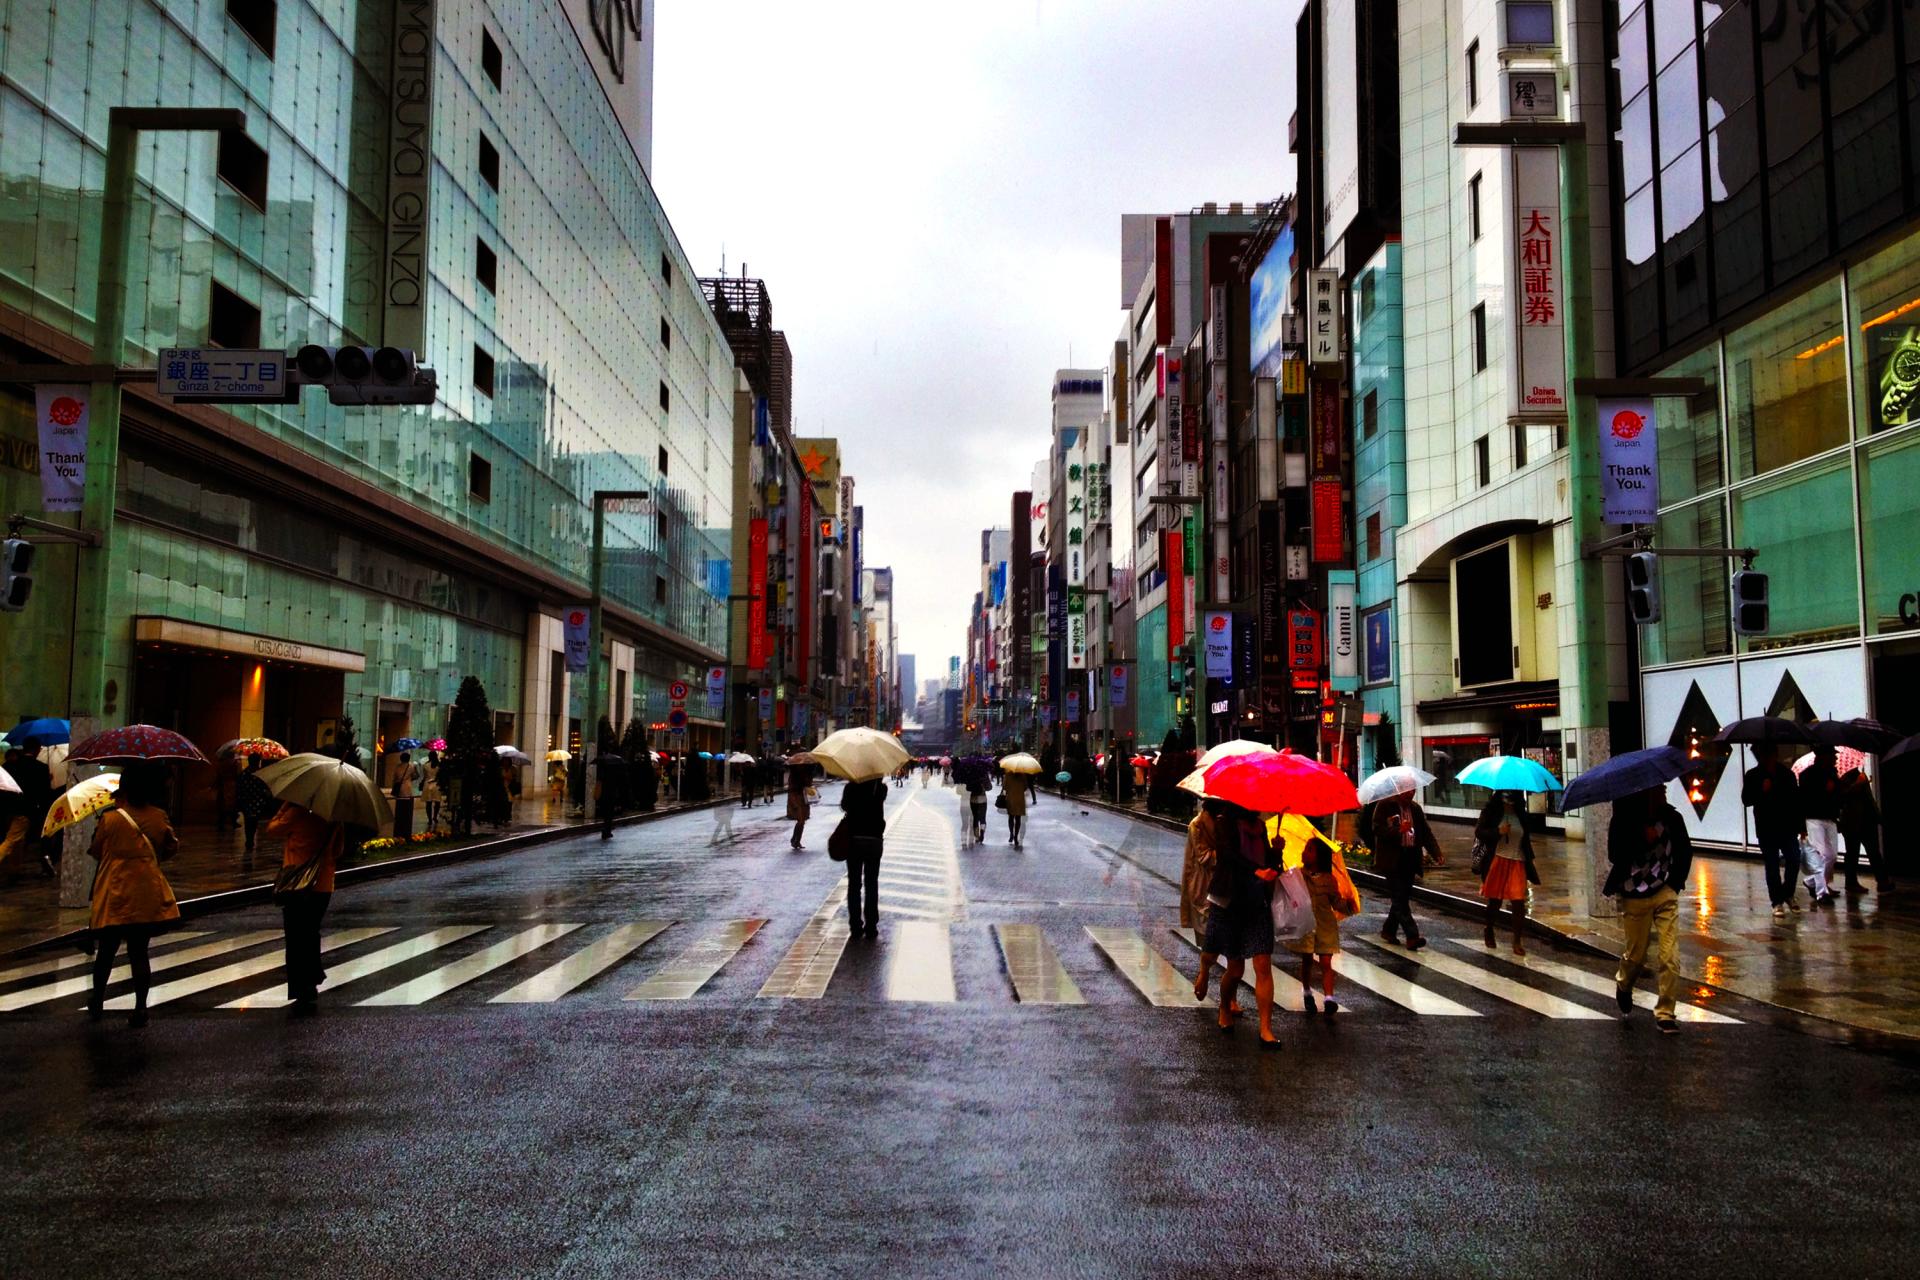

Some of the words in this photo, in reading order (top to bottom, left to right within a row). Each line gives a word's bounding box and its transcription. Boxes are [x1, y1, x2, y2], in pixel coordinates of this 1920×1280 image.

[1521, 209, 1555, 326] 大和証券
[1317, 278, 1332, 356] 南風ビル
[167, 350, 201, 360] 中央区
[166, 360, 277, 381] 銀座二丁目
[178, 381, 208, 392] Ginza
[213, 381, 264, 392] 2-chome
[1532, 385, 1556, 397] Daiwa
[1525, 395, 1562, 405] Securities
[52, 426, 78, 437] Japan
[1614, 439, 1641, 449] Japan
[46, 452, 85, 464] Thank
[55, 465, 79, 478] You.
[1607, 464, 1651, 477] Thank
[1616, 477, 1646, 490] You.
[1335, 606, 1352, 657] Camui
